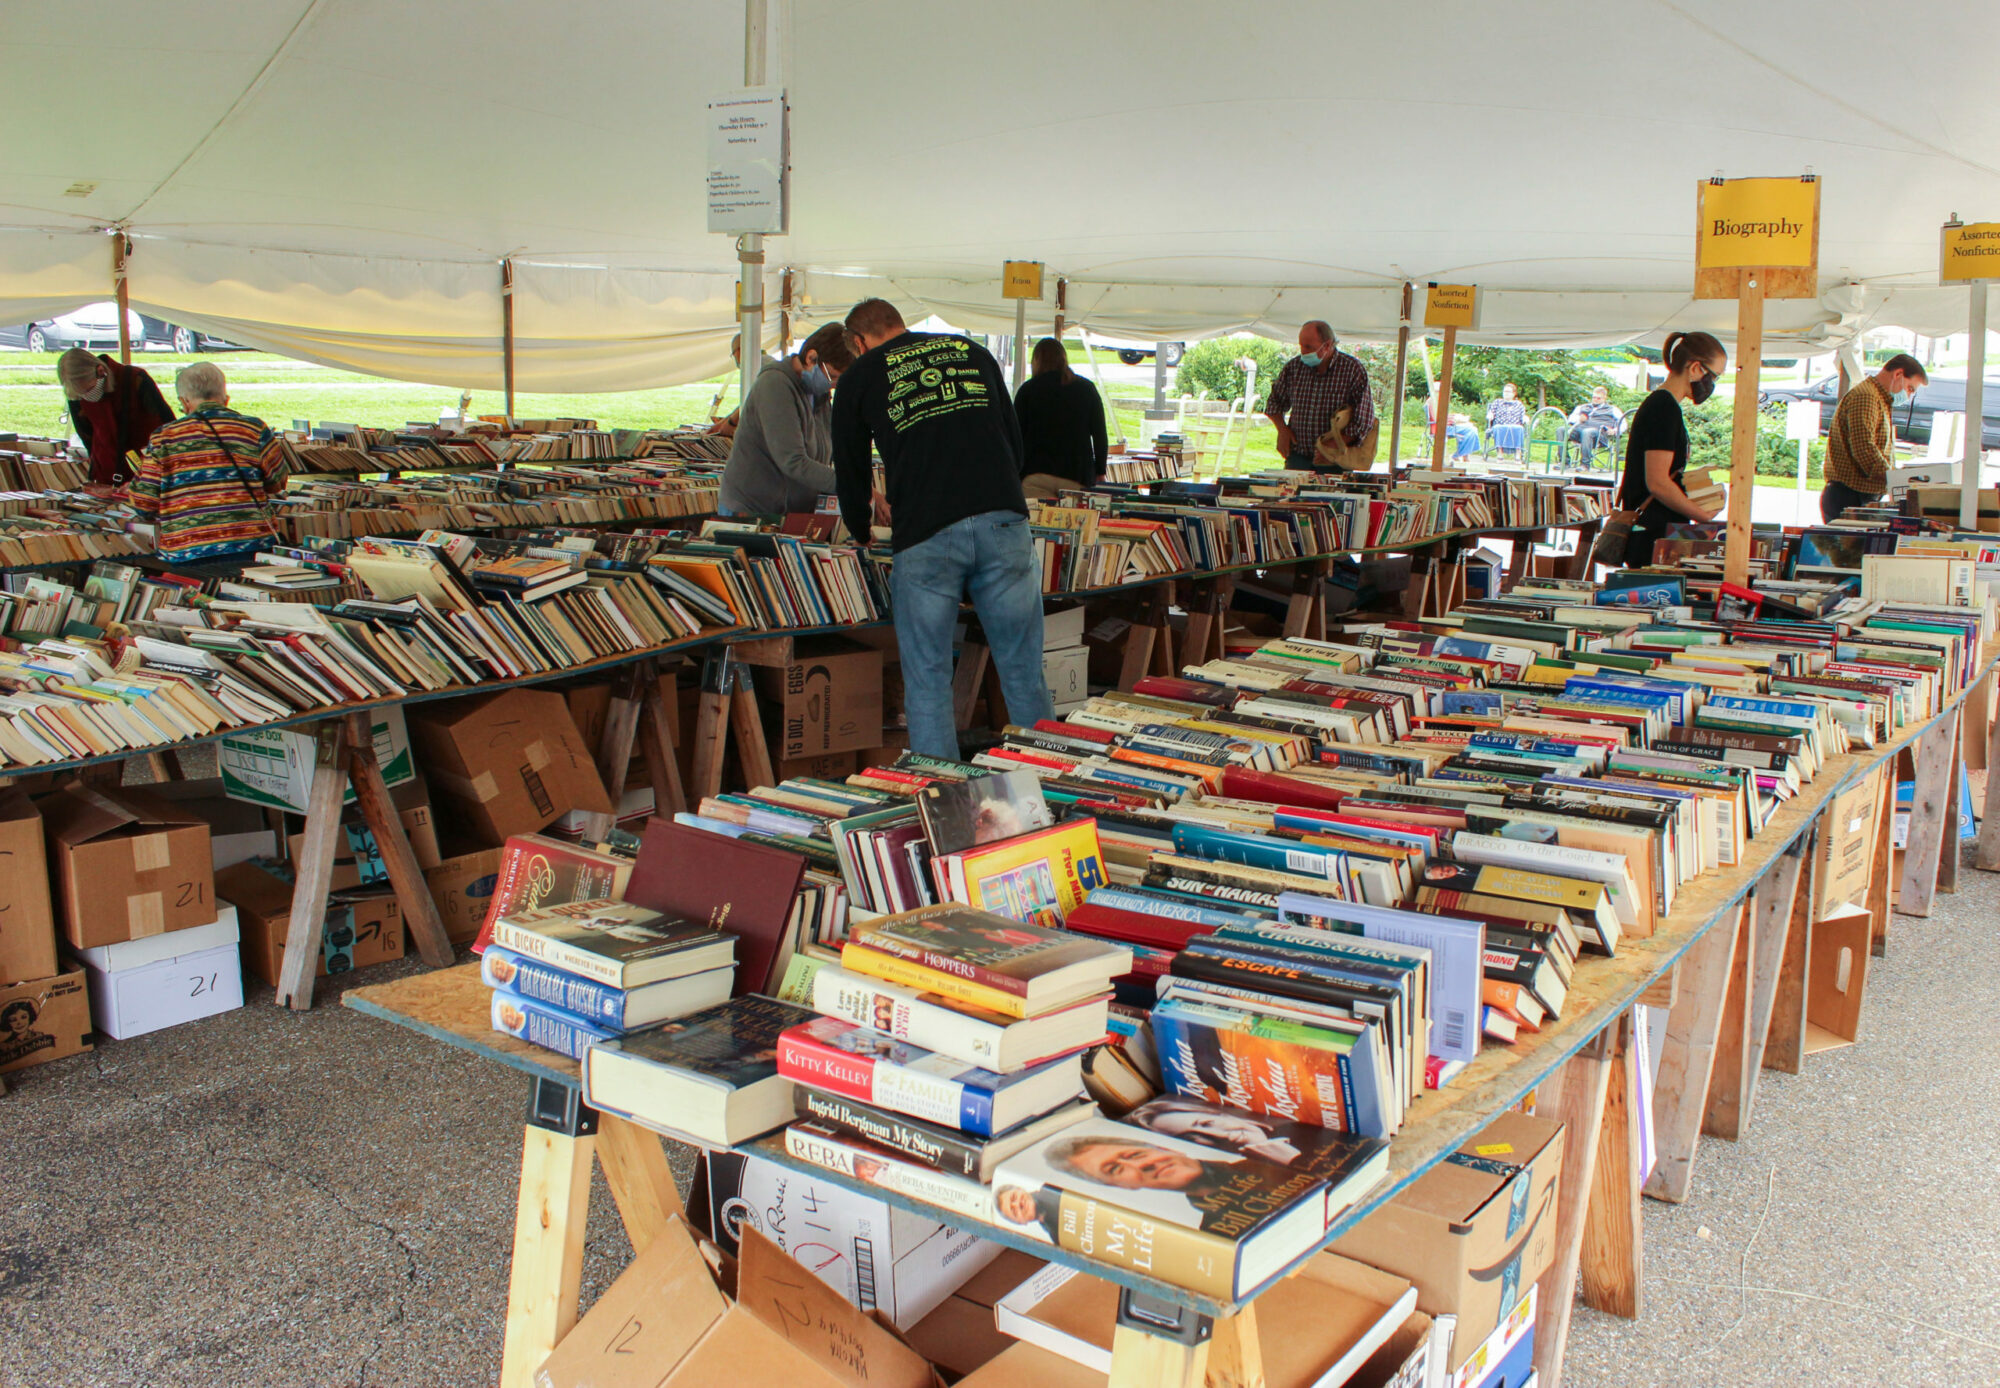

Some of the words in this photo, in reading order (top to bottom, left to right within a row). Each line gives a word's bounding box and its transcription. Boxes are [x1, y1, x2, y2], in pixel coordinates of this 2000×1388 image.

[1712, 217, 1803, 238] Biography
[1952, 245, 2000, 257] Nonfictio
[1432, 300, 1470, 310] Nonfiction
[1437, 289, 1468, 298] Assorted
[788, 664, 804, 694] EGGS
[266, 730, 284, 742] box
[788, 714, 804, 739] DOZ.
[1474, 735, 1515, 745] GABBY
[788, 742, 803, 757] 15
[1033, 740, 1068, 751] CHAPLAIN
[1656, 744, 1678, 752] DAYS
[1679, 745, 1690, 753] OF
[1692, 748, 1720, 758] GRACE
[1394, 786, 1423, 796] ROYAL
[1424, 789, 1454, 798] DUTY
[1458, 836, 1506, 851] BRACCO
[1516, 842, 1534, 854] On
[1536, 844, 1556, 858] the
[1558, 847, 1594, 864] Couch
[506, 848, 522, 888] ROBERT
[1062, 847, 1074, 878] Five
[1070, 879, 1084, 906] Min
[1076, 855, 1104, 892] 5
[175, 880, 206, 908] 21
[1213, 886, 1280, 907] HAMAS
[510, 908, 553, 924] R.A.
[556, 898, 619, 916] DICKEY
[880, 919, 902, 931] after
[904, 914, 919, 924] all
[920, 910, 942, 921] these
[944, 904, 970, 918] years
[1142, 901, 1202, 923] AMERICA
[381, 930, 398, 952] 16
[496, 926, 513, 949] R.A.
[514, 934, 546, 957] DICKEY
[876, 936, 886, 947] all
[1257, 930, 1331, 950] CHARLES
[1346, 946, 1401, 963] DIANA
[924, 952, 976, 978] HOPPERS
[1222, 958, 1304, 980] ESCAPE
[1272, 948, 1342, 964] HOPKINS
[52, 980, 76, 990] FRAGILE
[54, 990, 66, 998] NOT
[188, 971, 219, 998] 21
[520, 964, 566, 1006] BARBARA
[566, 979, 597, 1018] BUSH
[837, 990, 845, 1010] Love
[852, 998, 861, 1020] Build
[860, 993, 868, 1022] Bridge
[528, 1008, 572, 1058] BARBARA
[785, 1048, 823, 1072] KITTY
[825, 1060, 870, 1087] KELLEY
[1169, 1038, 1209, 1102] Joshua
[1212, 1048, 1253, 1112] Joshua
[898, 1073, 955, 1106] FAMILY
[1258, 1058, 1299, 1122] Joshua
[807, 1094, 840, 1123] Ingrid
[840, 1106, 891, 1139] Bergman
[892, 1124, 914, 1150] My
[912, 1134, 945, 1159] Story
[792, 1138, 850, 1172] REBA
[1194, 1187, 1230, 1214] My
[1229, 1174, 1264, 1205] Life
[1210, 1208, 1251, 1237] Bill
[1249, 1171, 1316, 1217] Clinton
[1063, 1208, 1077, 1236] Bill
[1080, 1200, 1098, 1256] Clinton
[1106, 1217, 1128, 1260] My
[1133, 1220, 1156, 1272] Life
[604, 1314, 643, 1355] 12
